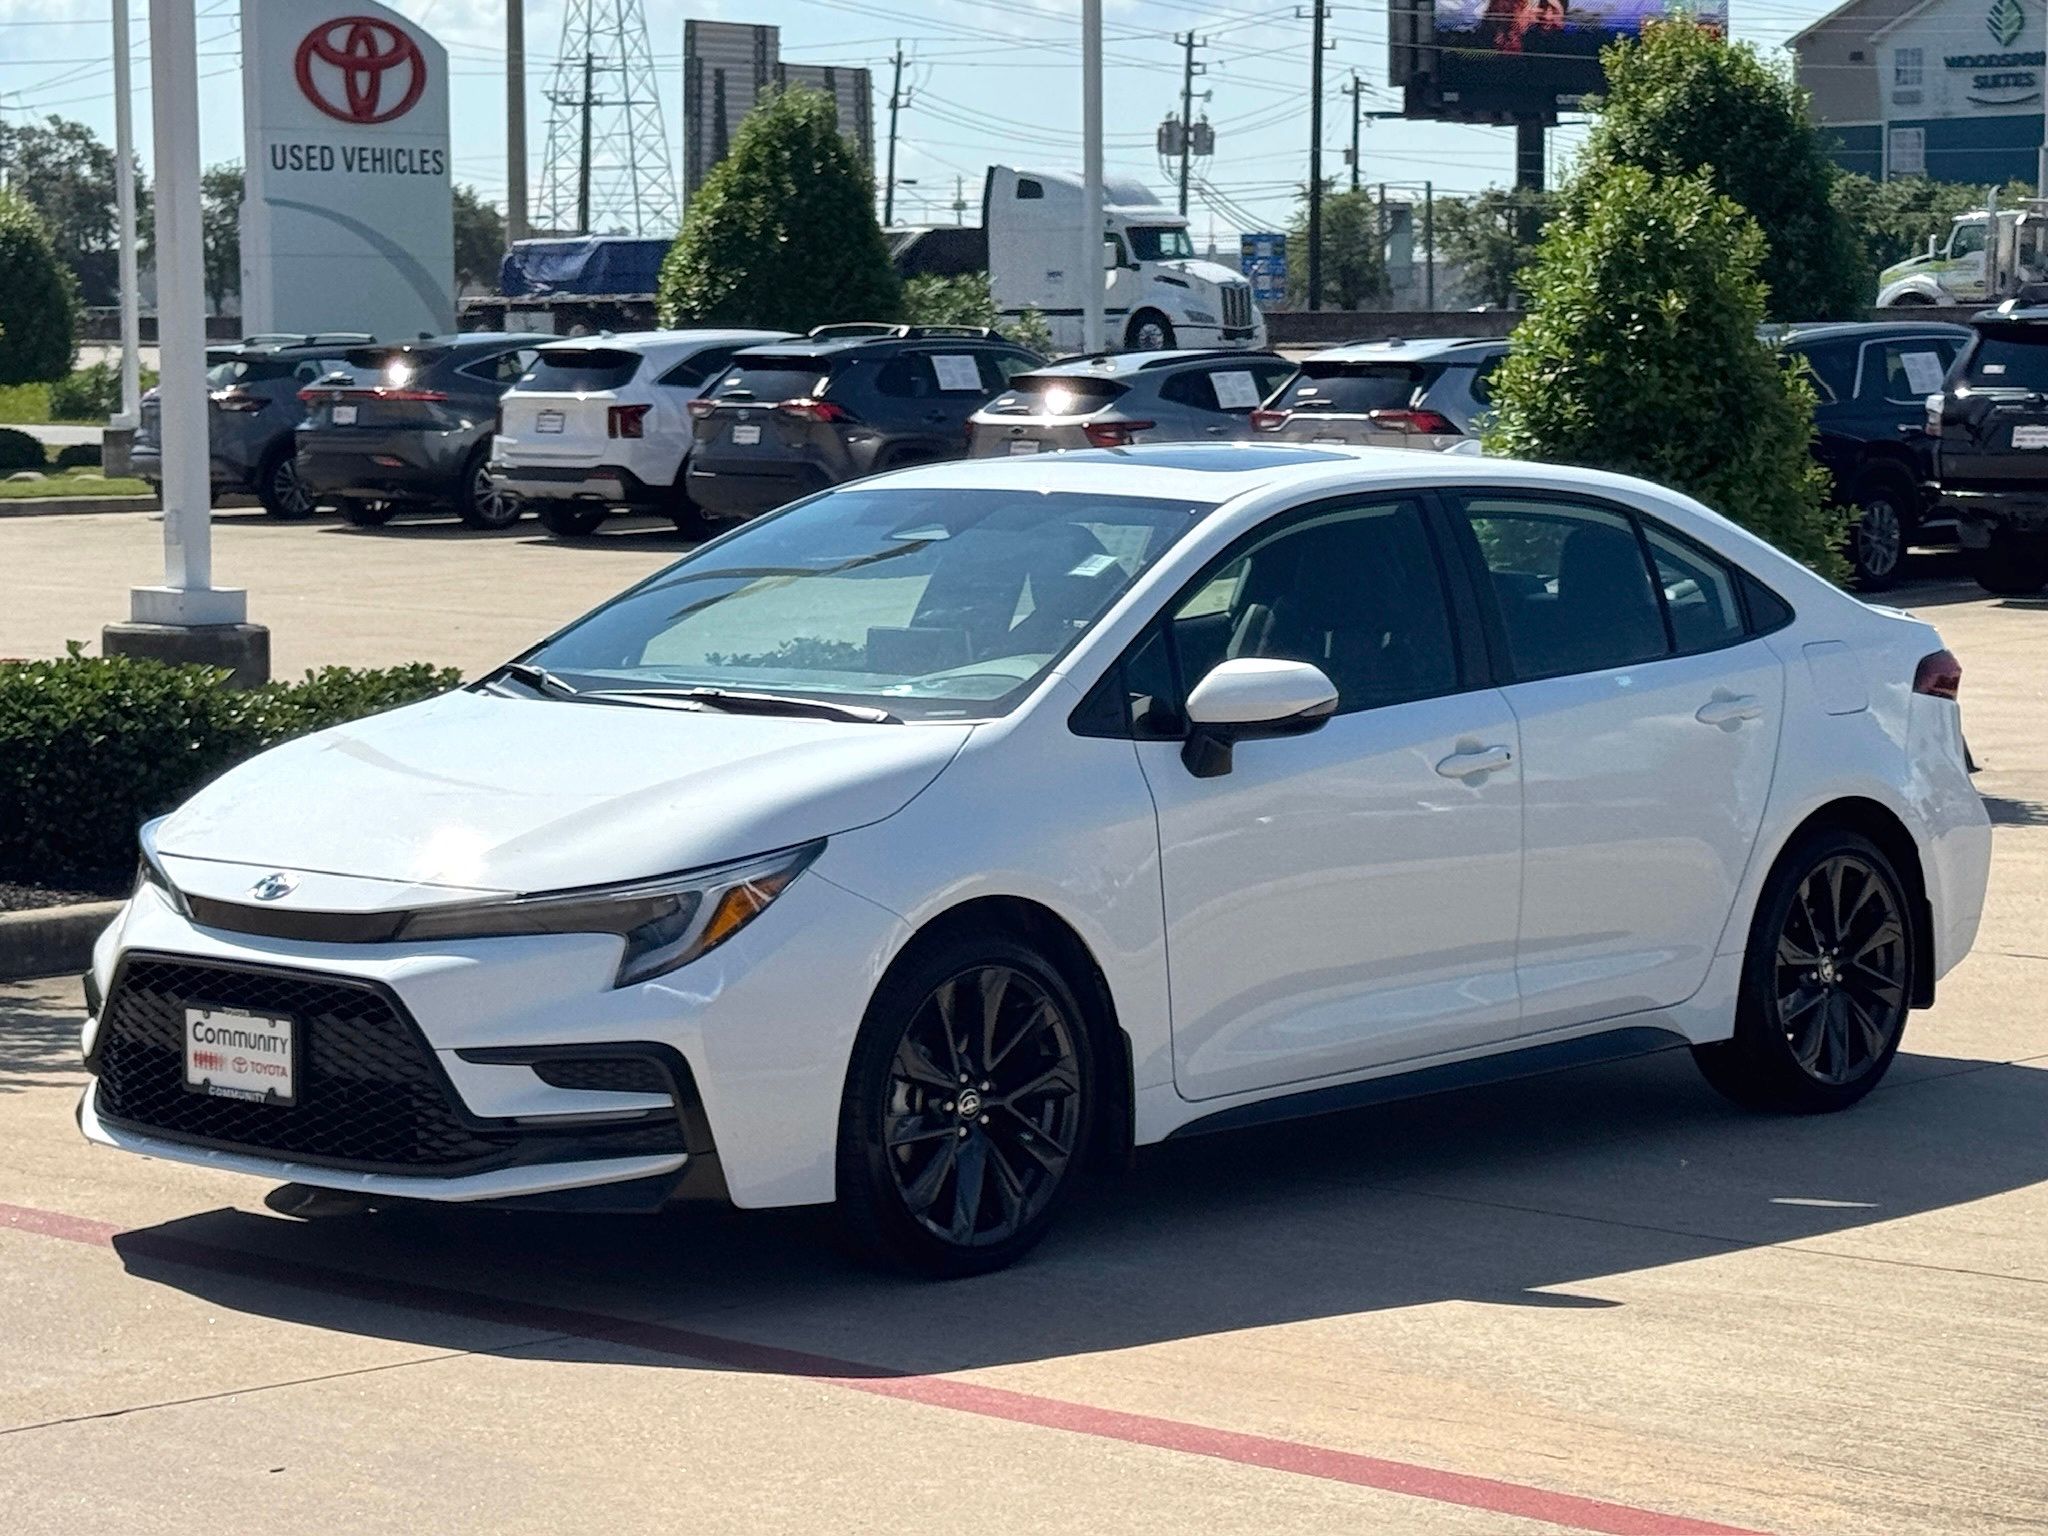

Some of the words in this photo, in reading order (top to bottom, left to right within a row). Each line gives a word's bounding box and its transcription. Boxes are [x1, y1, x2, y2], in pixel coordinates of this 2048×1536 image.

[271, 144, 335, 172] USED
[341, 146, 444, 175] VEHICLES
[250, 1061, 288, 1077] TOYOTA
